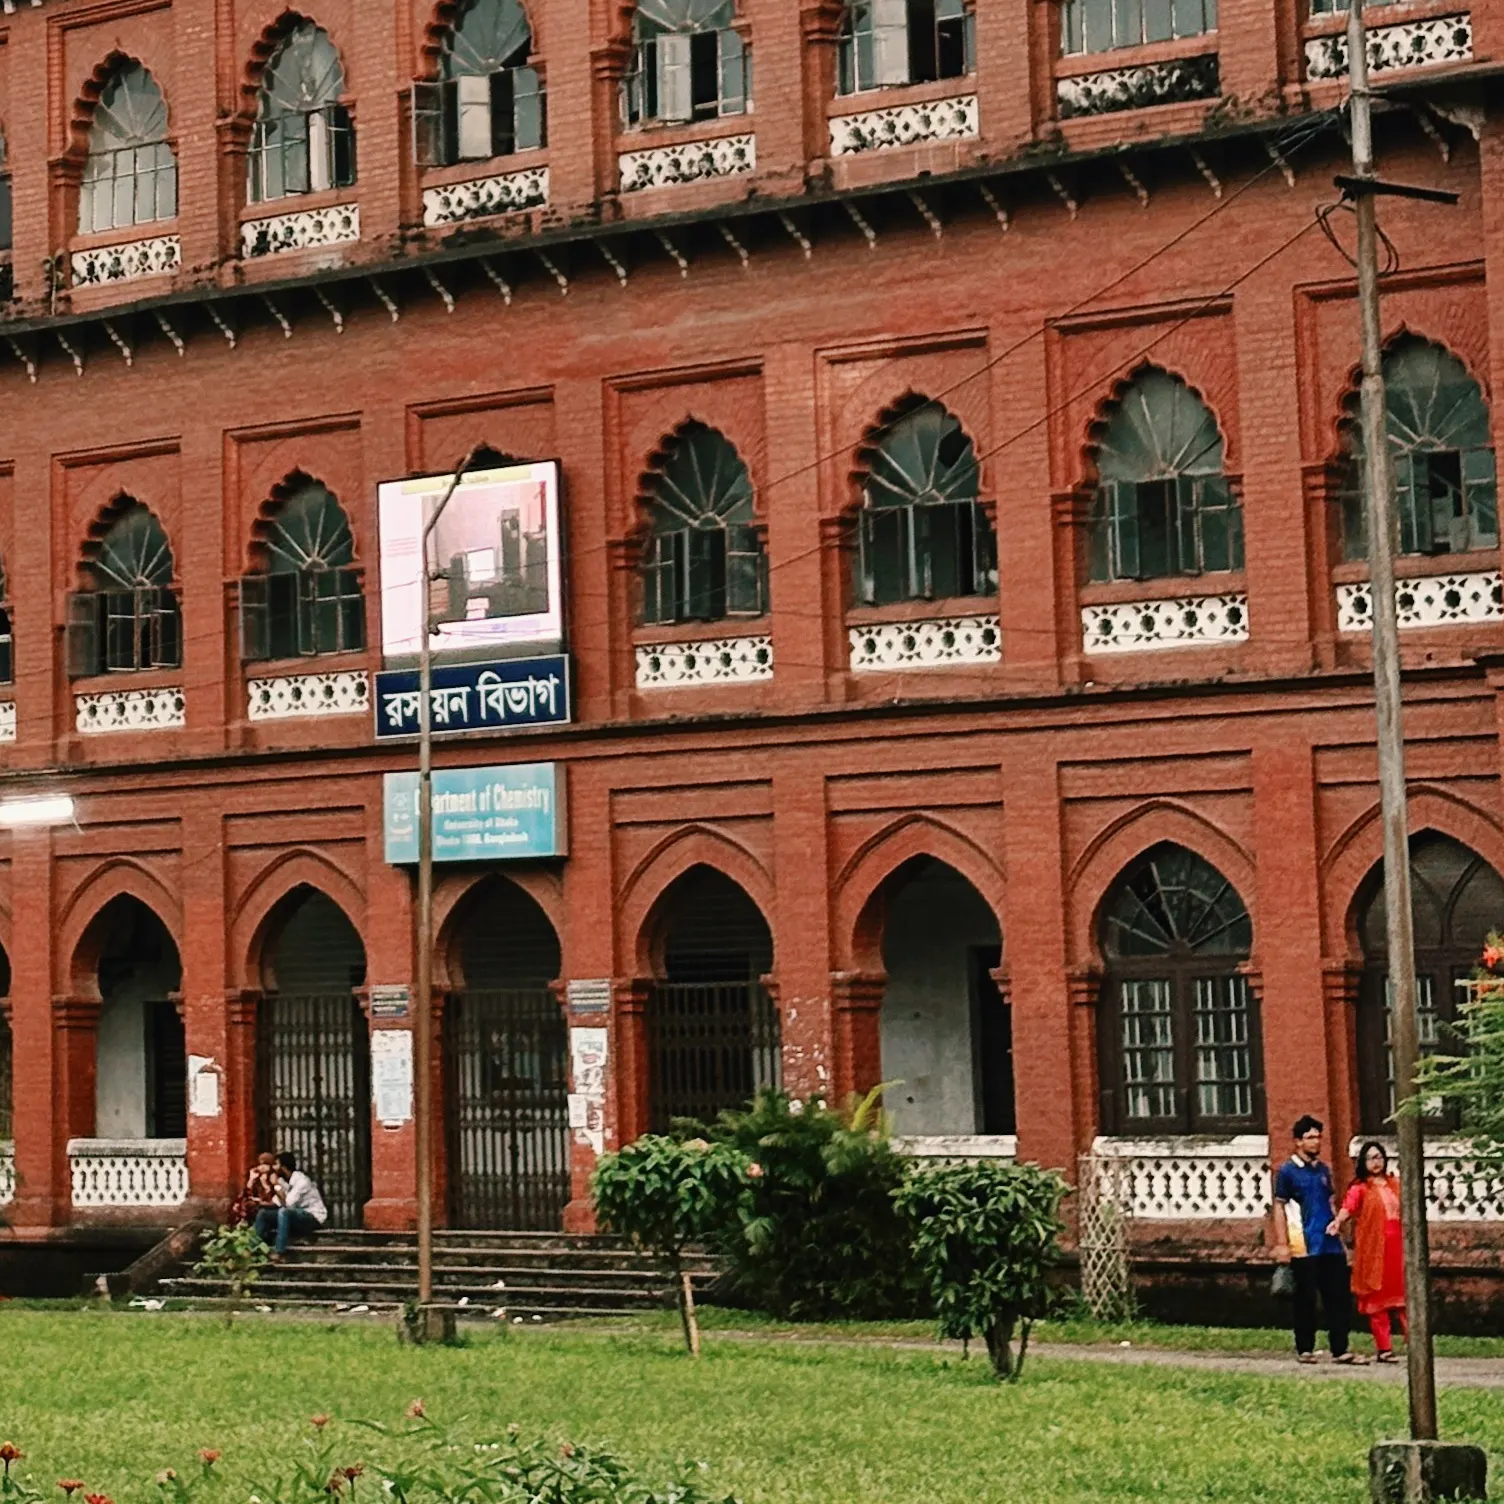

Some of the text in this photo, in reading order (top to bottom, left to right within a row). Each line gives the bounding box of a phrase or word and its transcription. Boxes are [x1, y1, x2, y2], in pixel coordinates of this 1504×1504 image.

[382, 670, 560, 727] রসয়ন বিভাগ
[414, 783, 550, 816] Dartment of Chemistry
